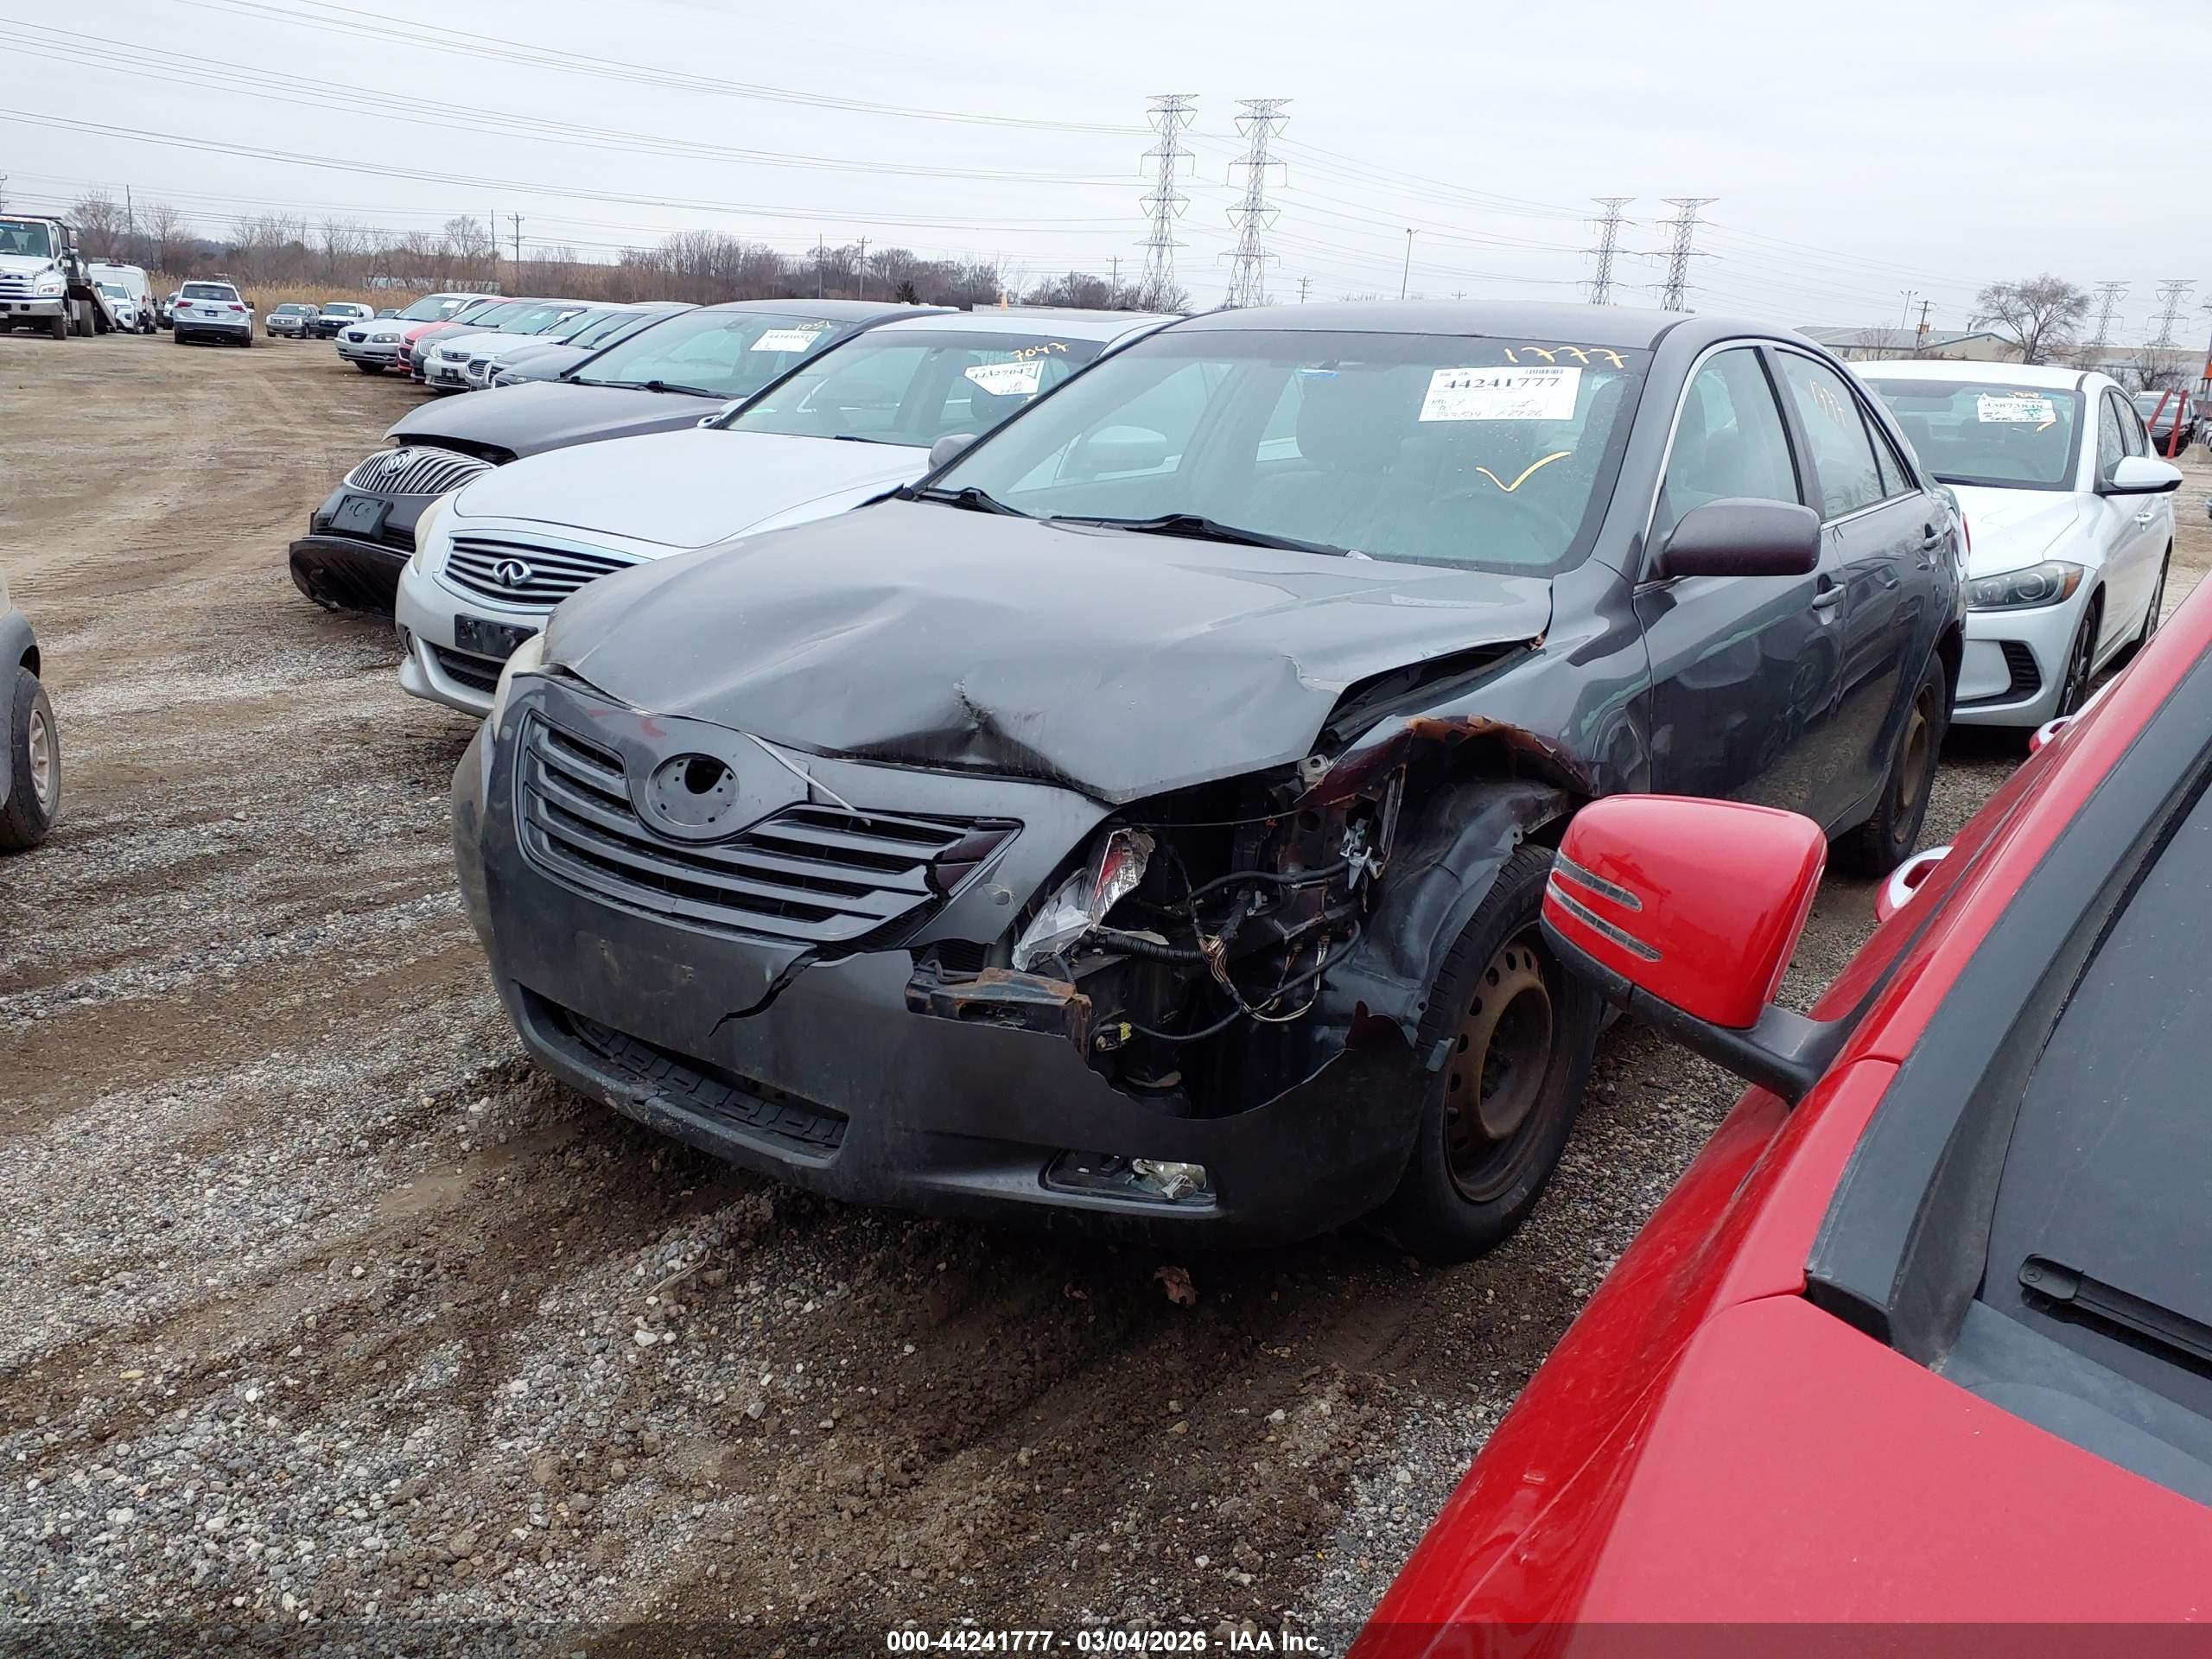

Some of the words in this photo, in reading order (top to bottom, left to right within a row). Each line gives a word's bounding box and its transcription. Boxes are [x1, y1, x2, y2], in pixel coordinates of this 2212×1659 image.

[1011, 342, 1069, 362] 7047
[1503, 346, 1630, 369] 1777
[970, 367, 1033, 380] 44327047
[1444, 377, 1561, 390] 44241777
